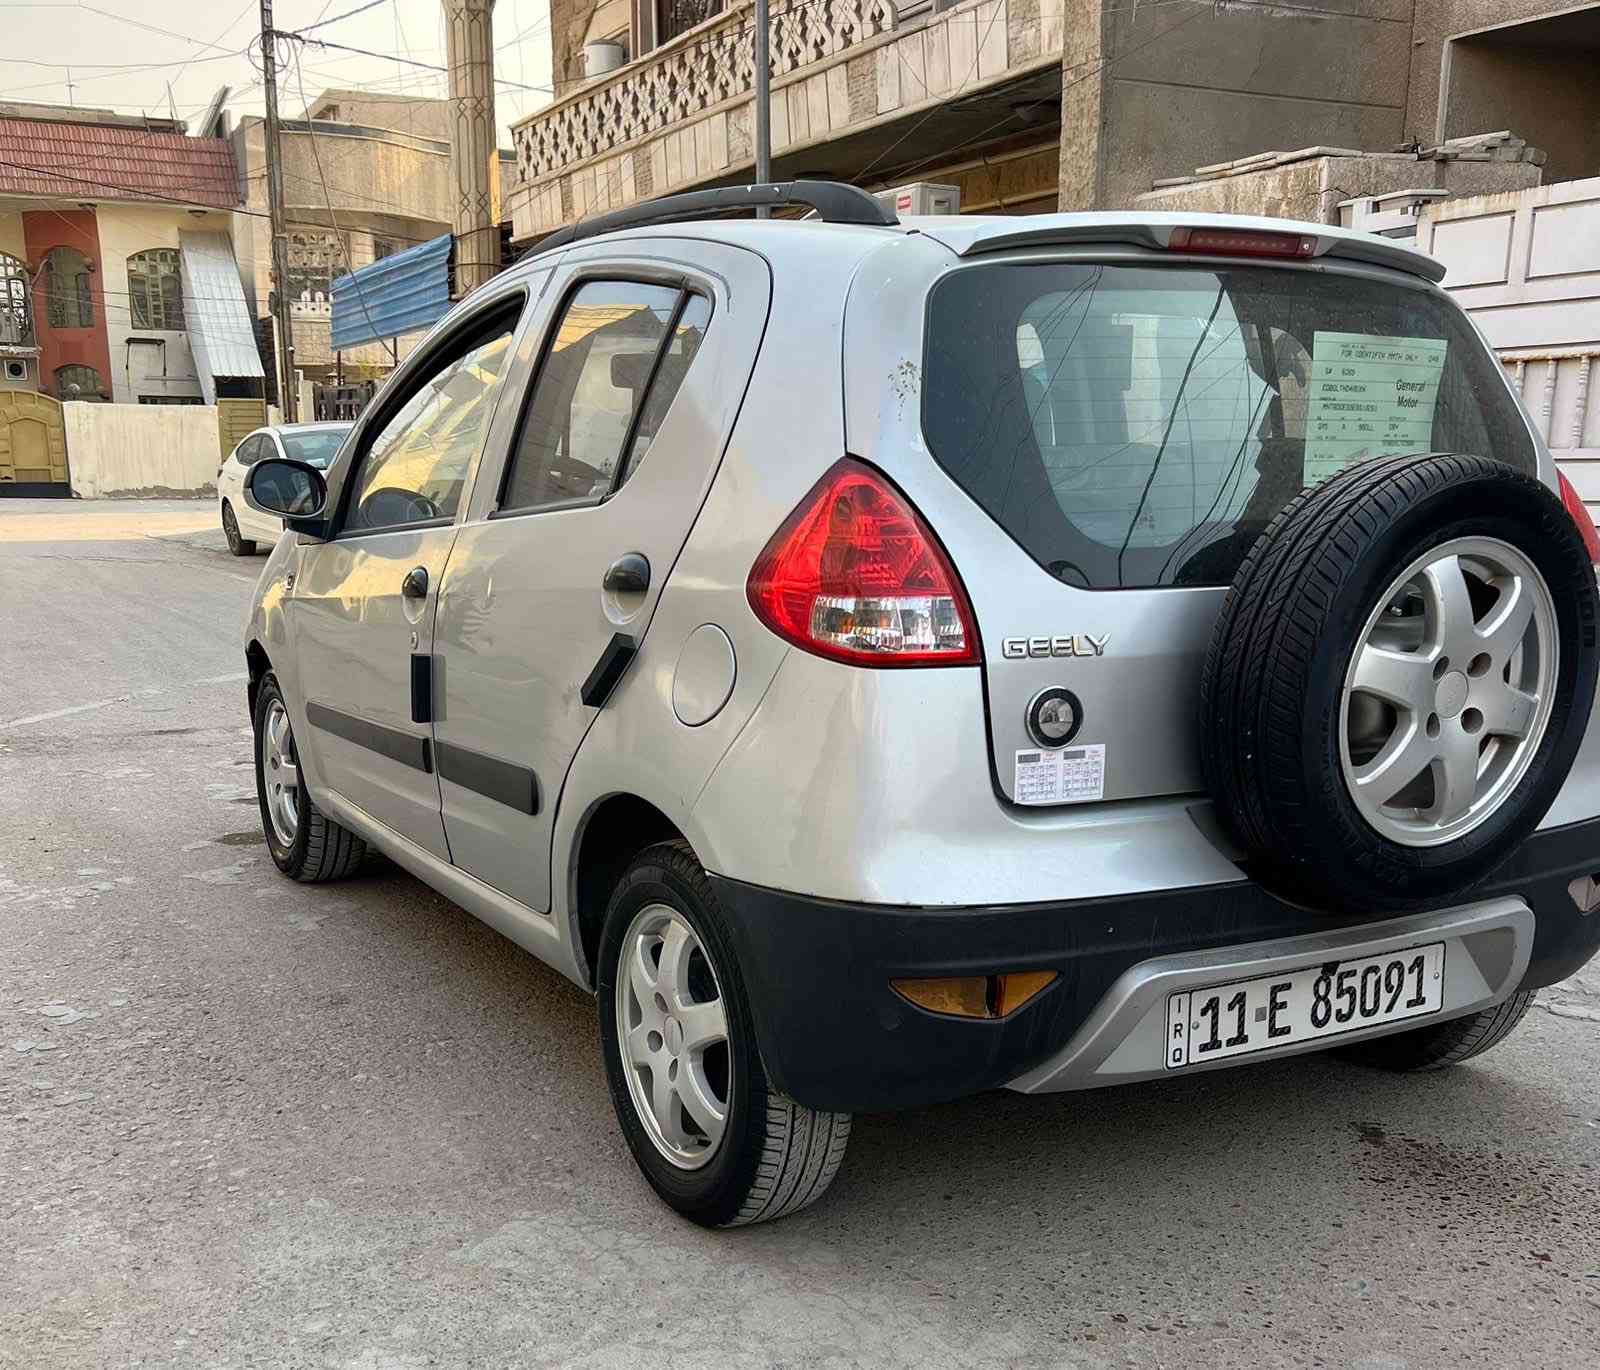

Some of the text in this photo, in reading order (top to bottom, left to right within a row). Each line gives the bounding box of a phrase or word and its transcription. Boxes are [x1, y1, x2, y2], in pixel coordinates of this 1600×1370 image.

[1395, 378, 1426, 393] General
[1397, 396, 1419, 408] Motor
[1002, 632, 1112, 658] GEELY
[1198, 955, 1426, 1053] 11 E 85091
[1172, 998, 1183, 1063] IRQ
